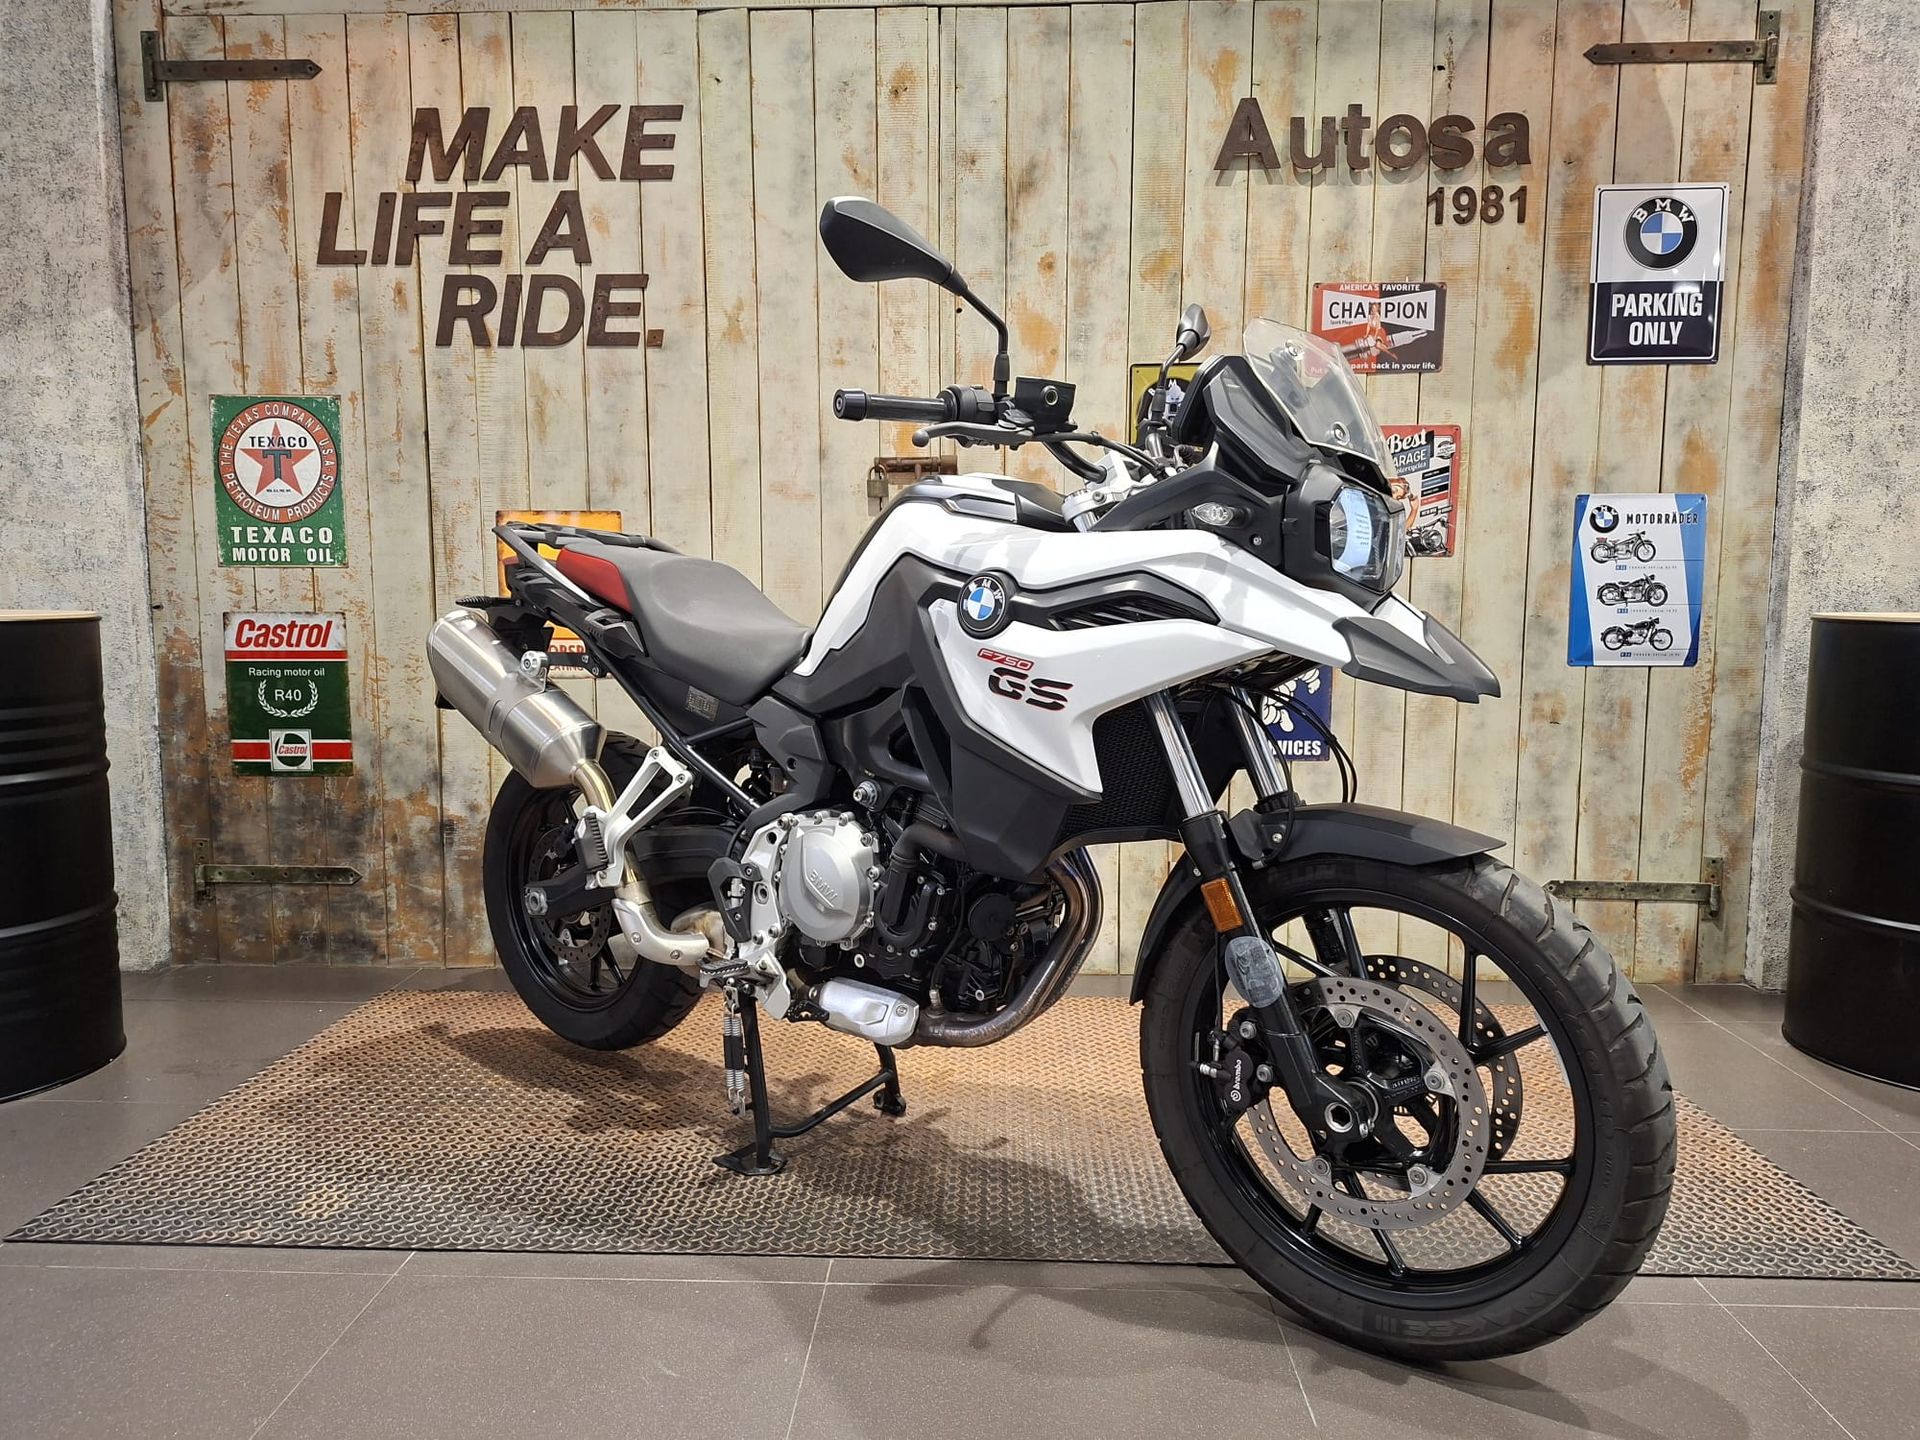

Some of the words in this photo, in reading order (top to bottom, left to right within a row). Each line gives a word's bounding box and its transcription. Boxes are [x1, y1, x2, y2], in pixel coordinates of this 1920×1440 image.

[405, 104, 684, 181] MAKE
[1213, 97, 1531, 171] Autosa
[1426, 185, 1528, 225] 1981
[1632, 198, 1695, 224] BMW
[316, 190, 511, 265] LIFE
[526, 190, 592, 264] A
[1382, 283, 1421, 291] FAVORITE
[435, 273, 665, 347] RIDE.
[1611, 292, 1703, 318] PARKING
[1628, 321, 1684, 346] ONLY
[1351, 362, 1369, 371] park
[1371, 361, 1390, 370] back
[1392, 361, 1400, 369] in
[1402, 363, 1420, 371] your
[1422, 361, 1436, 370] life
[220, 444, 233, 468] THE
[227, 407, 260, 439] TEXAS
[265, 403, 322, 434] COMPANY
[249, 436, 308, 448] TEXACO
[1387, 428, 1427, 453] Best
[263, 450, 292, 480] T
[1393, 449, 1427, 468] ARAGE
[223, 473, 281, 521] PETROLEUM
[287, 474, 334, 521] PRODUCTS
[1626, 512, 1698, 525] MOTORRÄDER
[231, 526, 333, 545] TEXACO
[233, 547, 291, 563] MOTOR
[307, 547, 335, 563] OIL
[968, 578, 1004, 603] BMW
[235, 618, 333, 649] Castrol
[979, 649, 1033, 670] F750
[248, 667, 281, 678] Racing
[284, 668, 311, 677] motor
[313, 667, 325, 677] oil
[274, 689, 302, 702] R40
[988, 666, 1075, 711] GS
[277, 743, 308, 755] Castrol
[1268, 739, 1322, 757] VICES
[810, 868, 838, 902] BMW
